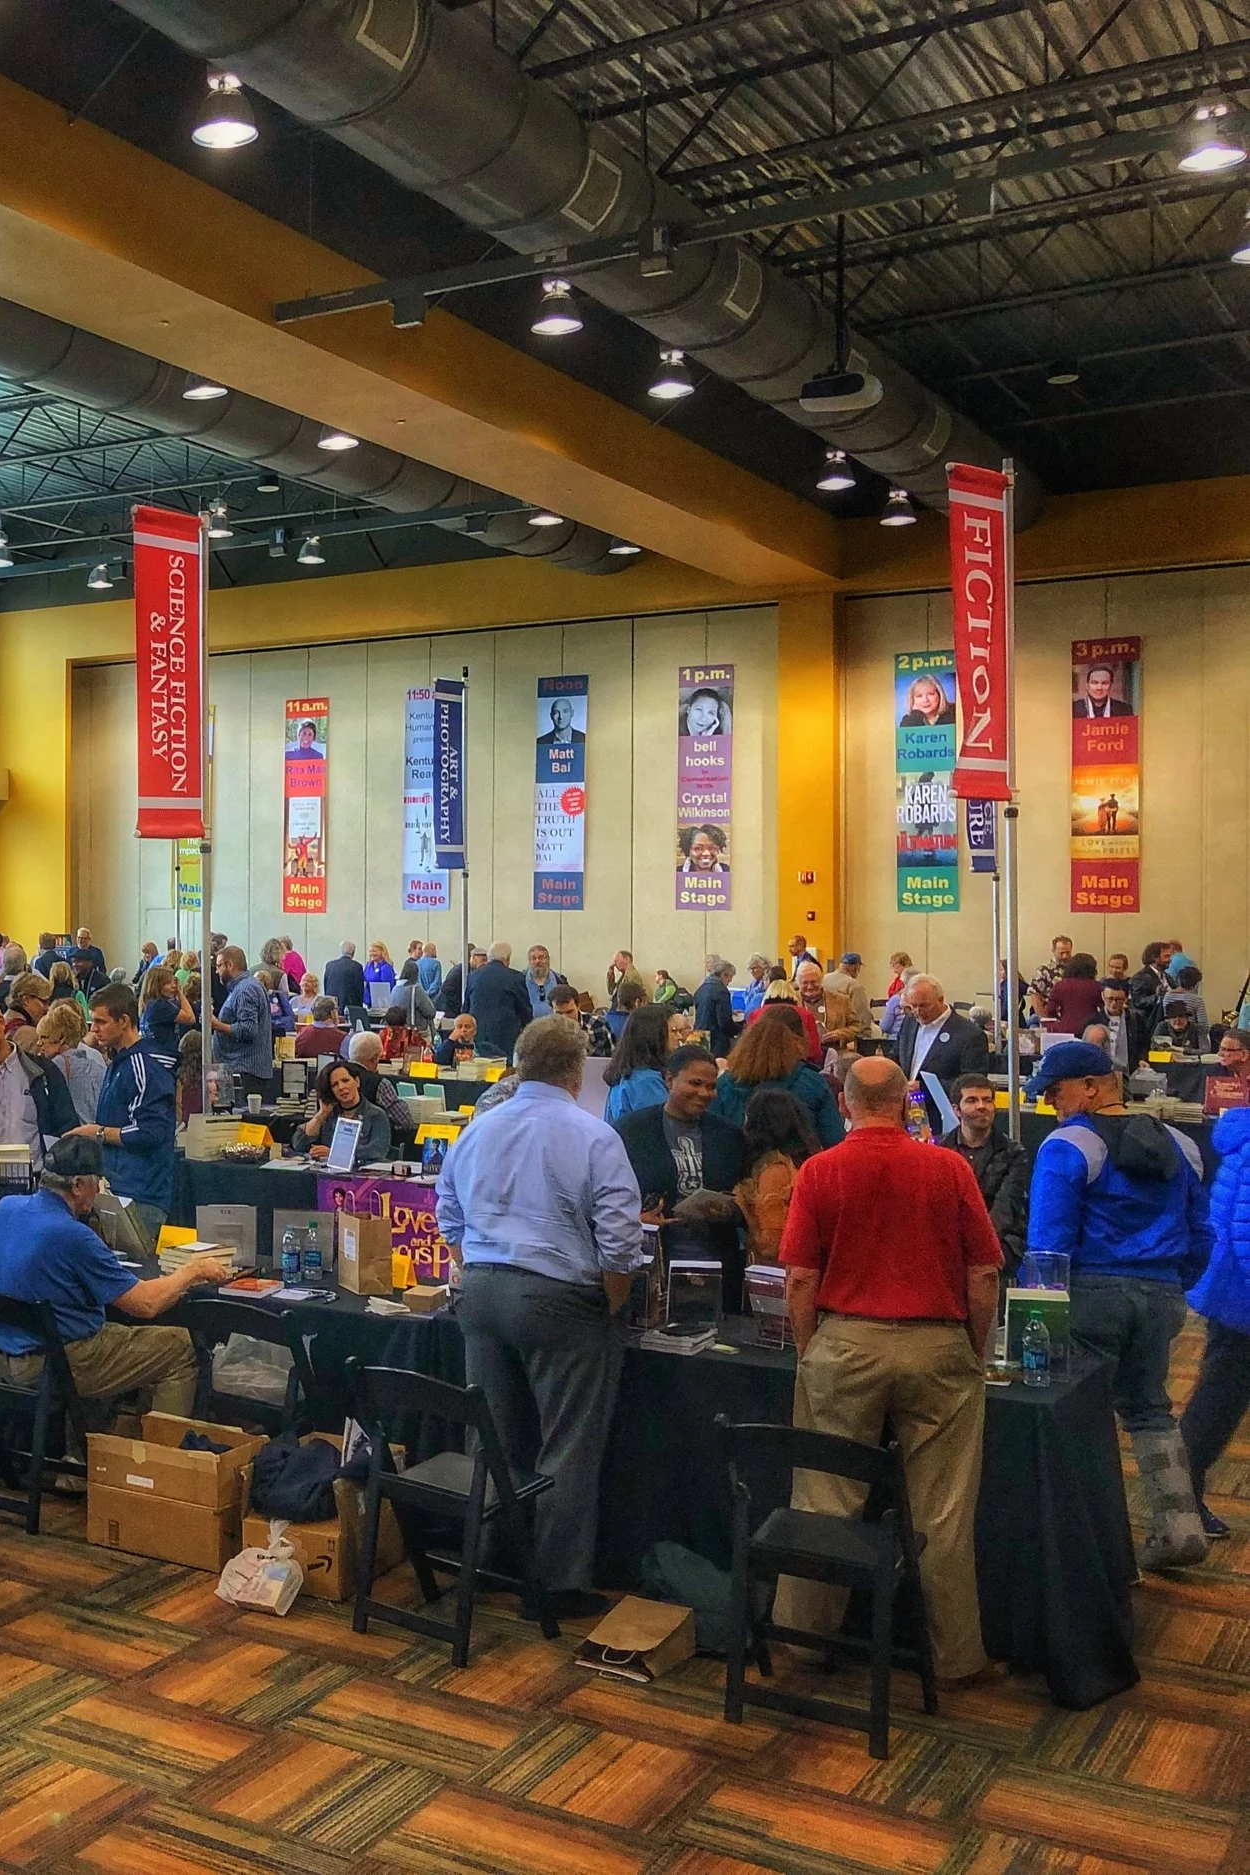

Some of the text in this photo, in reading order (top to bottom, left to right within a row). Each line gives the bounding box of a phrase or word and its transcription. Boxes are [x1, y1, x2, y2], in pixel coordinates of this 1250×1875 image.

[964, 511, 994, 752] FICTION
[1076, 643, 1088, 657] 3
[898, 654, 952, 670] 2 p.m.
[168, 554, 187, 793] SCIENCE FICTION
[682, 668, 730, 683] 1 p.m.
[149, 612, 168, 762] & FANTASY
[406, 689, 430, 701] 11:50
[287, 701, 328, 712] 11 a.m.
[1082, 722, 1129, 737] Jamie
[905, 732, 947, 744] Karen
[694, 741, 717, 752] bell
[1087, 739, 1124, 753] Ford
[549, 749, 574, 760] Matt
[897, 747, 955, 760] Robards
[450, 746, 458, 782] ART
[685, 756, 725, 767] hooks
[286, 765, 304, 774] Rita
[441, 703, 450, 843] PHOTOGRAPHY
[290, 779, 323, 787] Brown
[537, 789, 559, 798] ALL
[682, 792, 727, 806] Crystal
[905, 784, 947, 805] KAREN
[536, 802, 561, 811] THE
[678, 807, 731, 818] Wilkinson
[897, 803, 957, 824] ROBARDS
[536, 828, 574, 837] IS OUT
[536, 843, 564, 851] MATT
[411, 880, 442, 890] Main
[542, 878, 576, 890] Main
[685, 877, 722, 889] Main
[906, 876, 949, 889] Main
[1081, 875, 1129, 889] Main
[290, 884, 319, 894] Main
[287, 897, 322, 909] Stage
[407, 894, 445, 906] Stage
[538, 892, 579, 906] Stage
[680, 891, 726, 906] Stage
[902, 892, 955, 907] Stage
[1076, 892, 1134, 908] Stage
[410, 1236, 431, 1247] and
